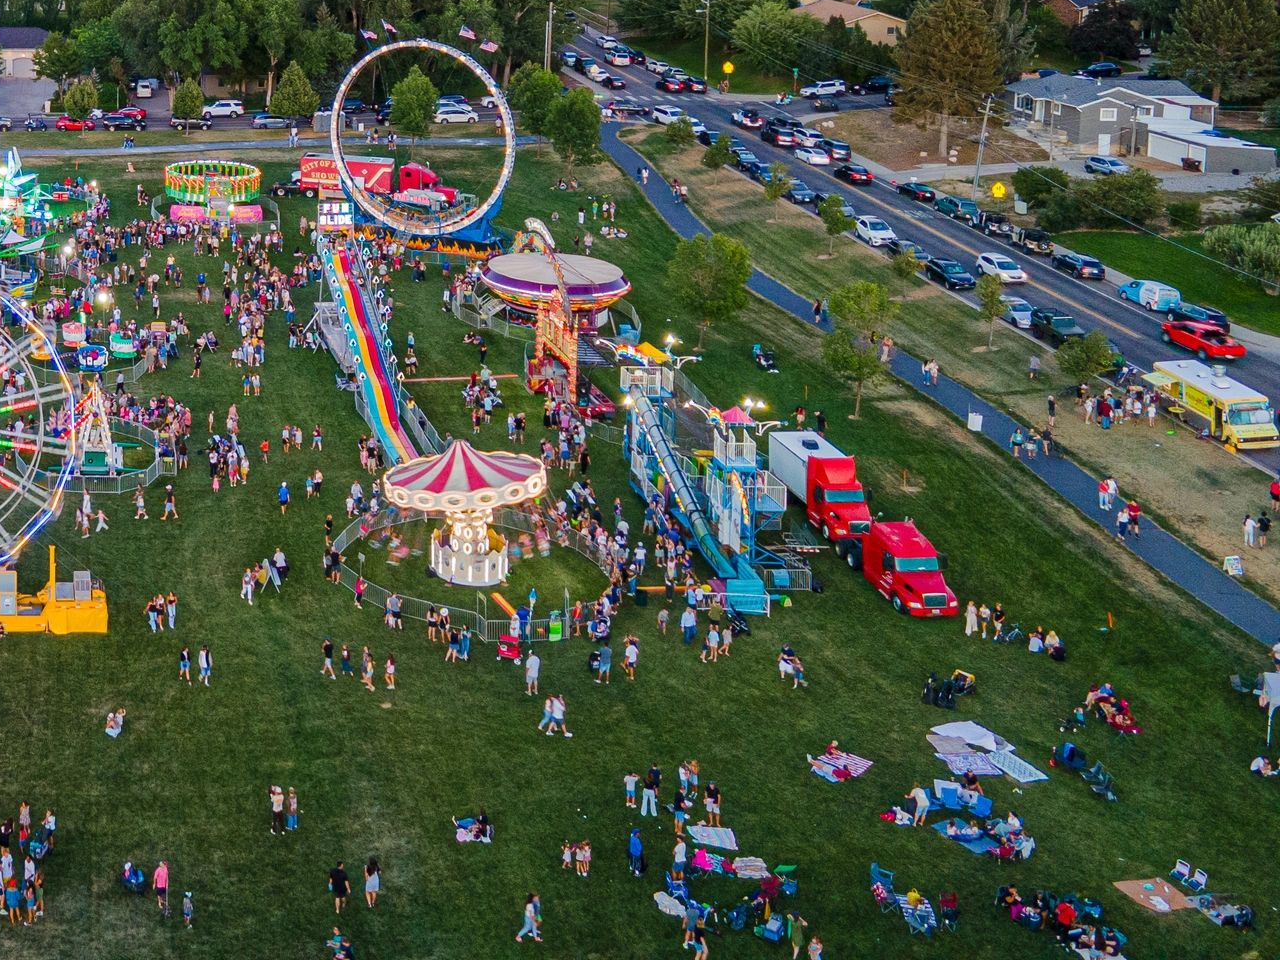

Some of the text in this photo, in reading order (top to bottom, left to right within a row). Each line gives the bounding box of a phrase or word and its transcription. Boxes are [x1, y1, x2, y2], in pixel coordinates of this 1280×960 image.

[302, 160, 318, 173] CITY
[319, 159, 331, 168] OF
[323, 202, 350, 214] FUN
[319, 214, 353, 225] SLIDE
